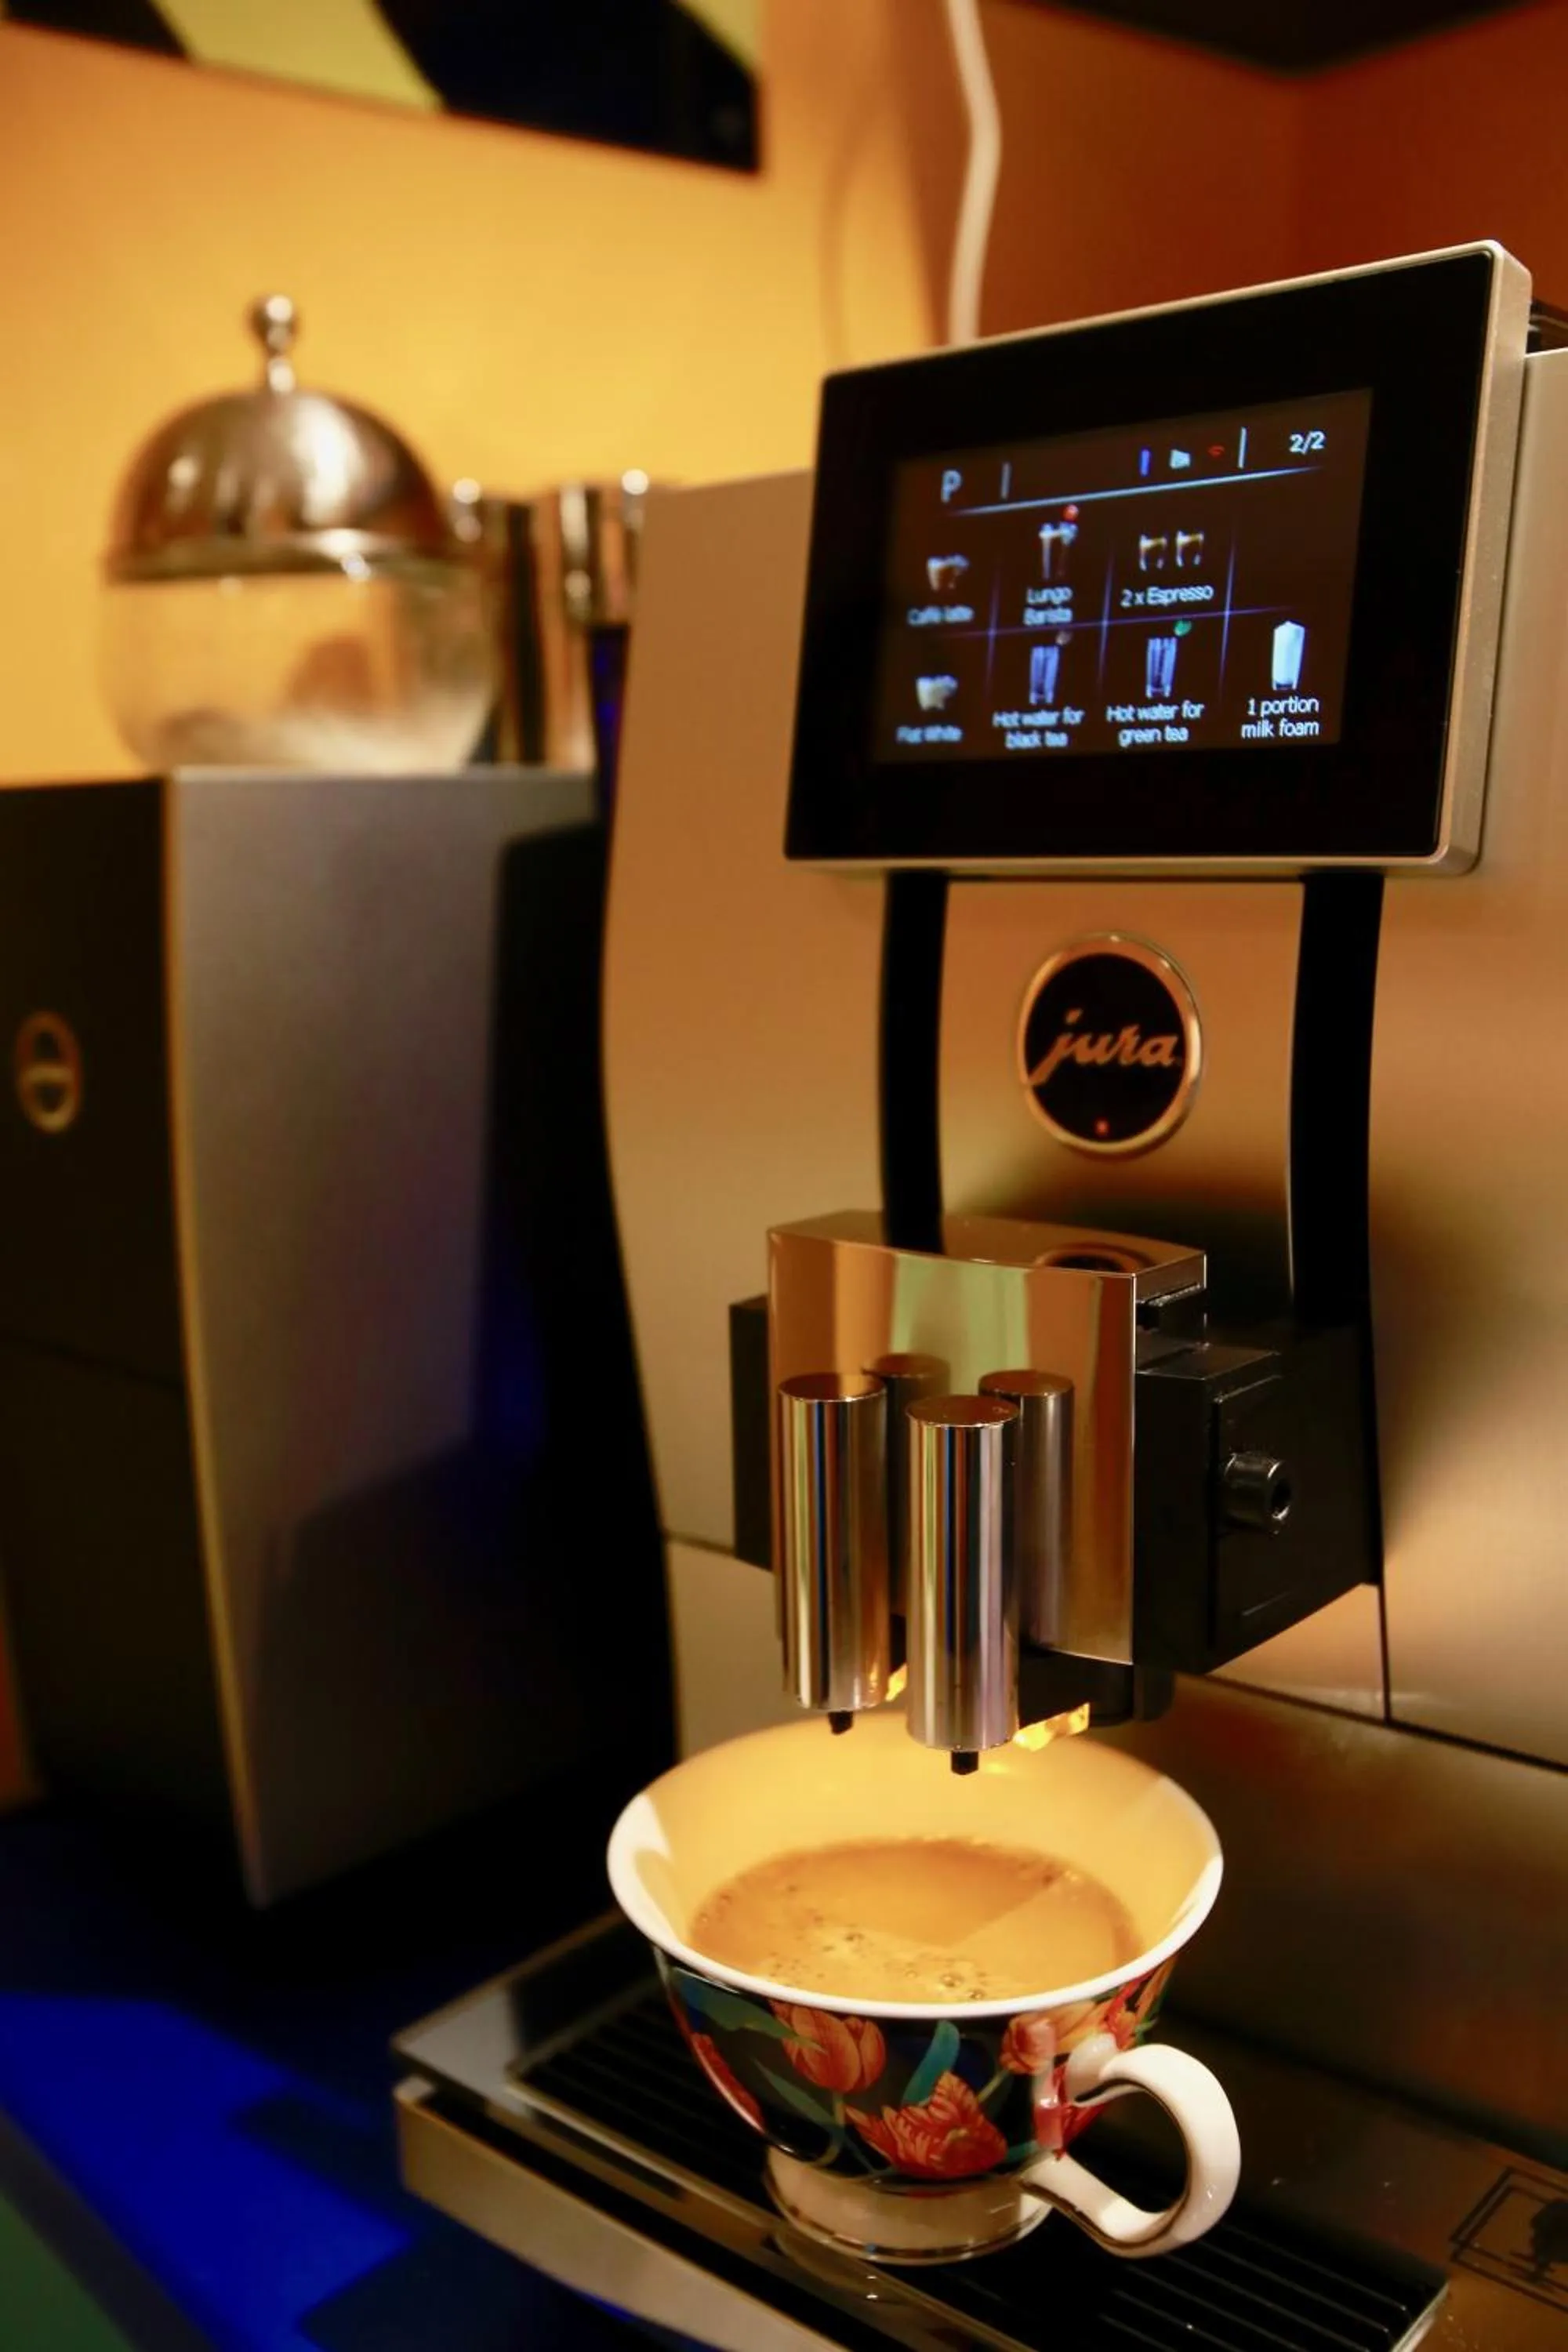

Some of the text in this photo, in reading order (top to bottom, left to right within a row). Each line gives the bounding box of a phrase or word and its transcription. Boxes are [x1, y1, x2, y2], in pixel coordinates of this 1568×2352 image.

[1289, 430, 1325, 454] 2/2
[1025, 586, 1073, 605] Lungo
[1120, 585, 1214, 608] 2 x Espresso
[992, 706, 1085, 728] Hot water for
[1106, 699, 1205, 722] Hot water for
[1247, 695, 1319, 718] 1 portion
[1118, 725, 1189, 747] green tea
[1241, 717, 1319, 739] milk foam
[1028, 1007, 1178, 1086] jura
